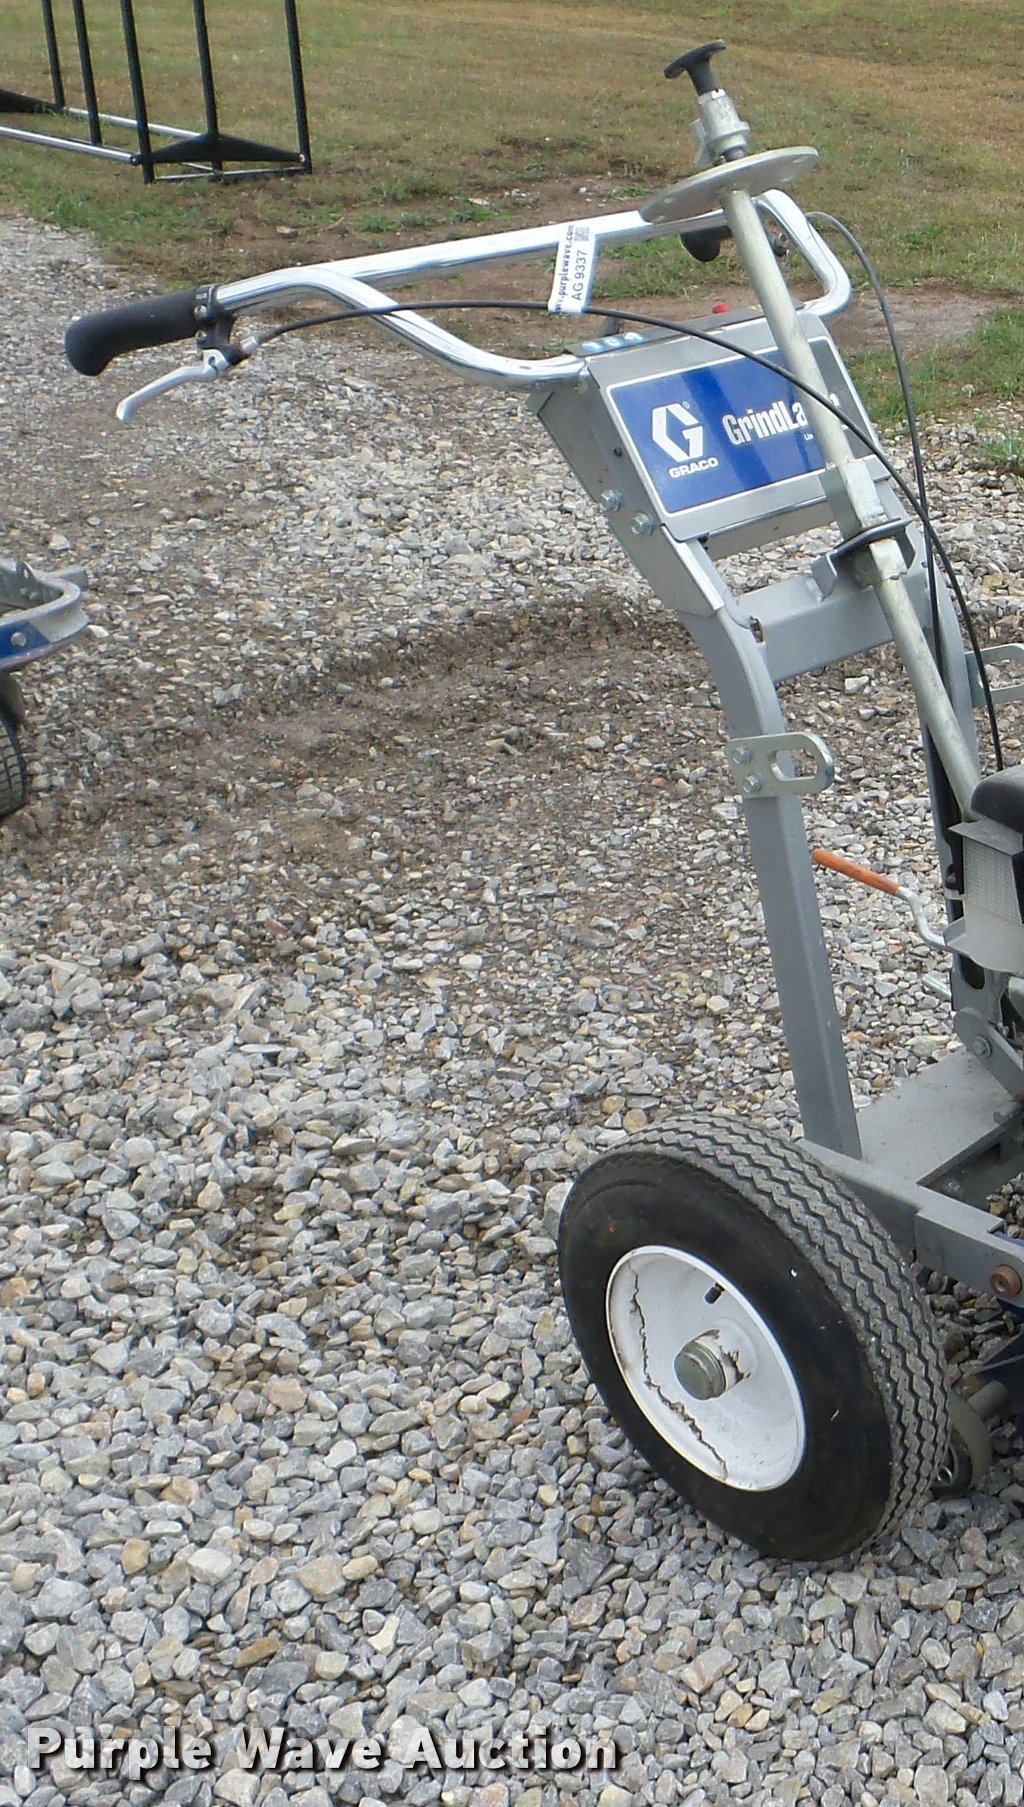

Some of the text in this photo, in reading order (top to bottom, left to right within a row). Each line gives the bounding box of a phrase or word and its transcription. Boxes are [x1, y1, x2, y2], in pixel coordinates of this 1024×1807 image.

[571, 250, 587, 301] AG 9337
[722, 393, 839, 446] GrindLa
[668, 457, 719, 478] GRACO
